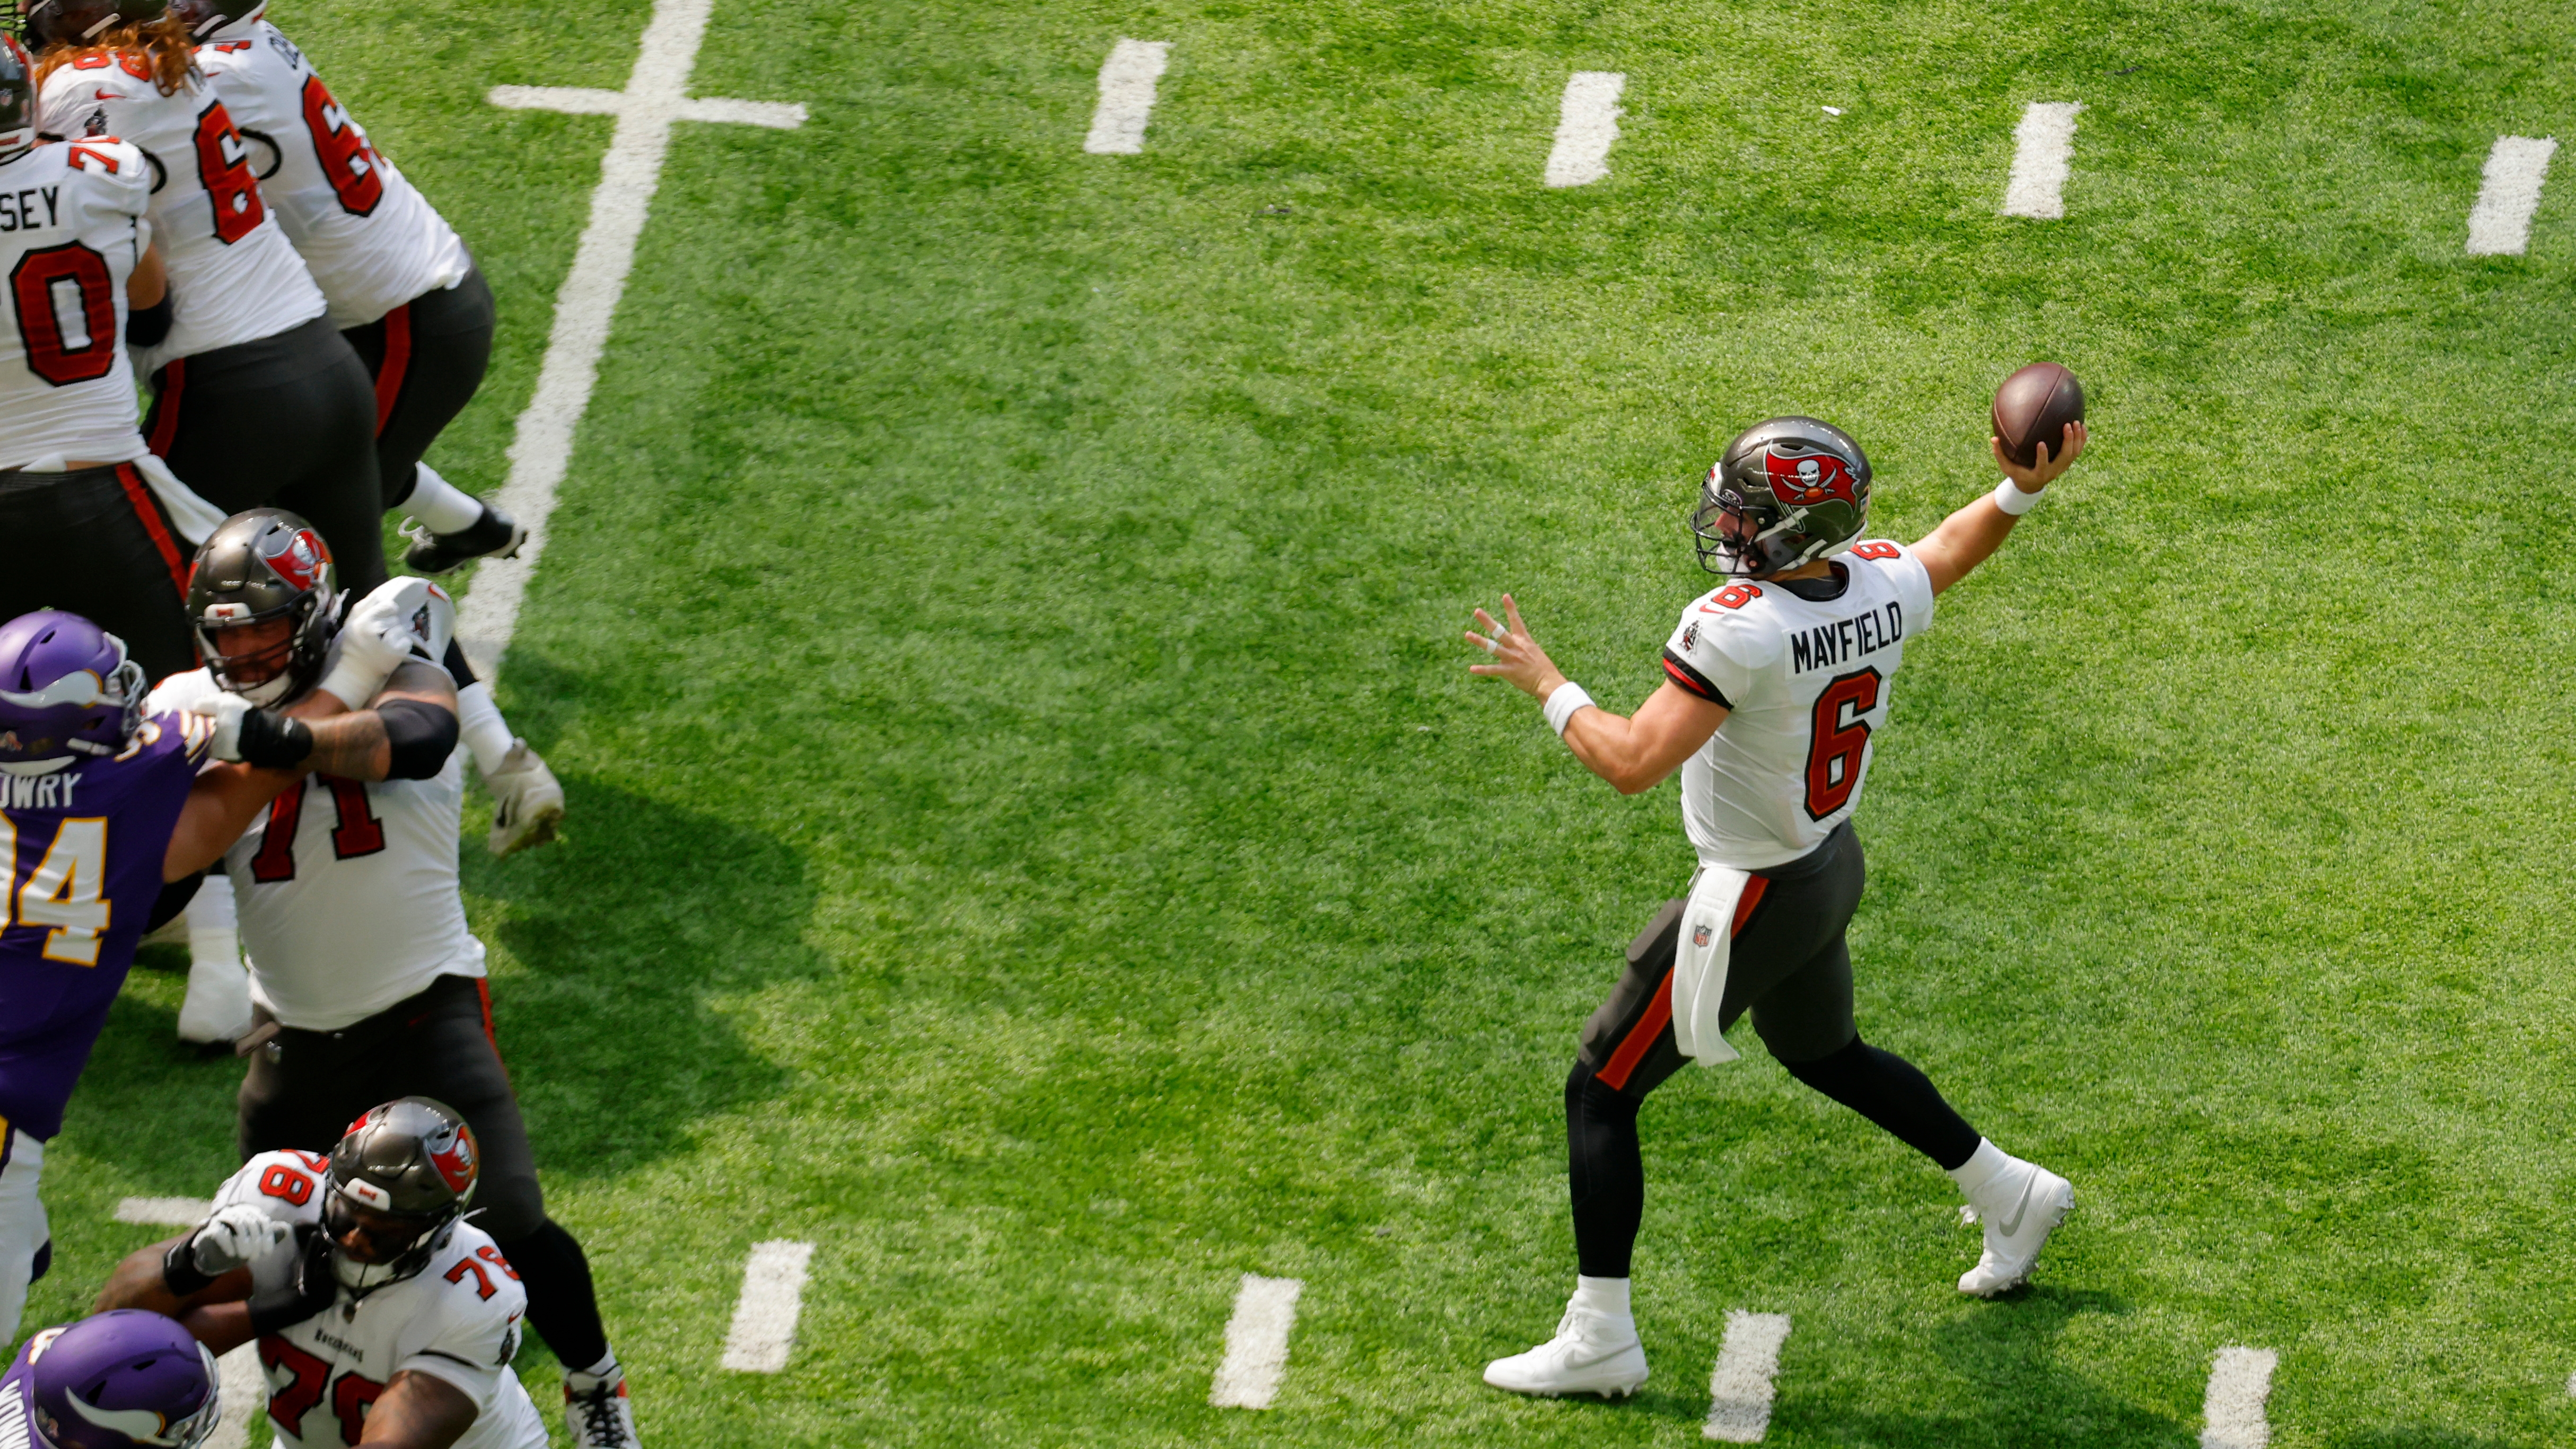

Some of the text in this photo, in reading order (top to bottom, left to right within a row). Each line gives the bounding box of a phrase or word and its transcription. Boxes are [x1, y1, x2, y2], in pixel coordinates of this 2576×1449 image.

[301, 73, 387, 218] 6
[0, 186, 58, 231] SEY
[1711, 584, 1763, 609] 6
[1791, 601, 1903, 674] MAYFIELD
[1804, 664, 1882, 822] 6
[0, 809, 111, 968] 4
[0, 1378, 31, 1449] WONN
